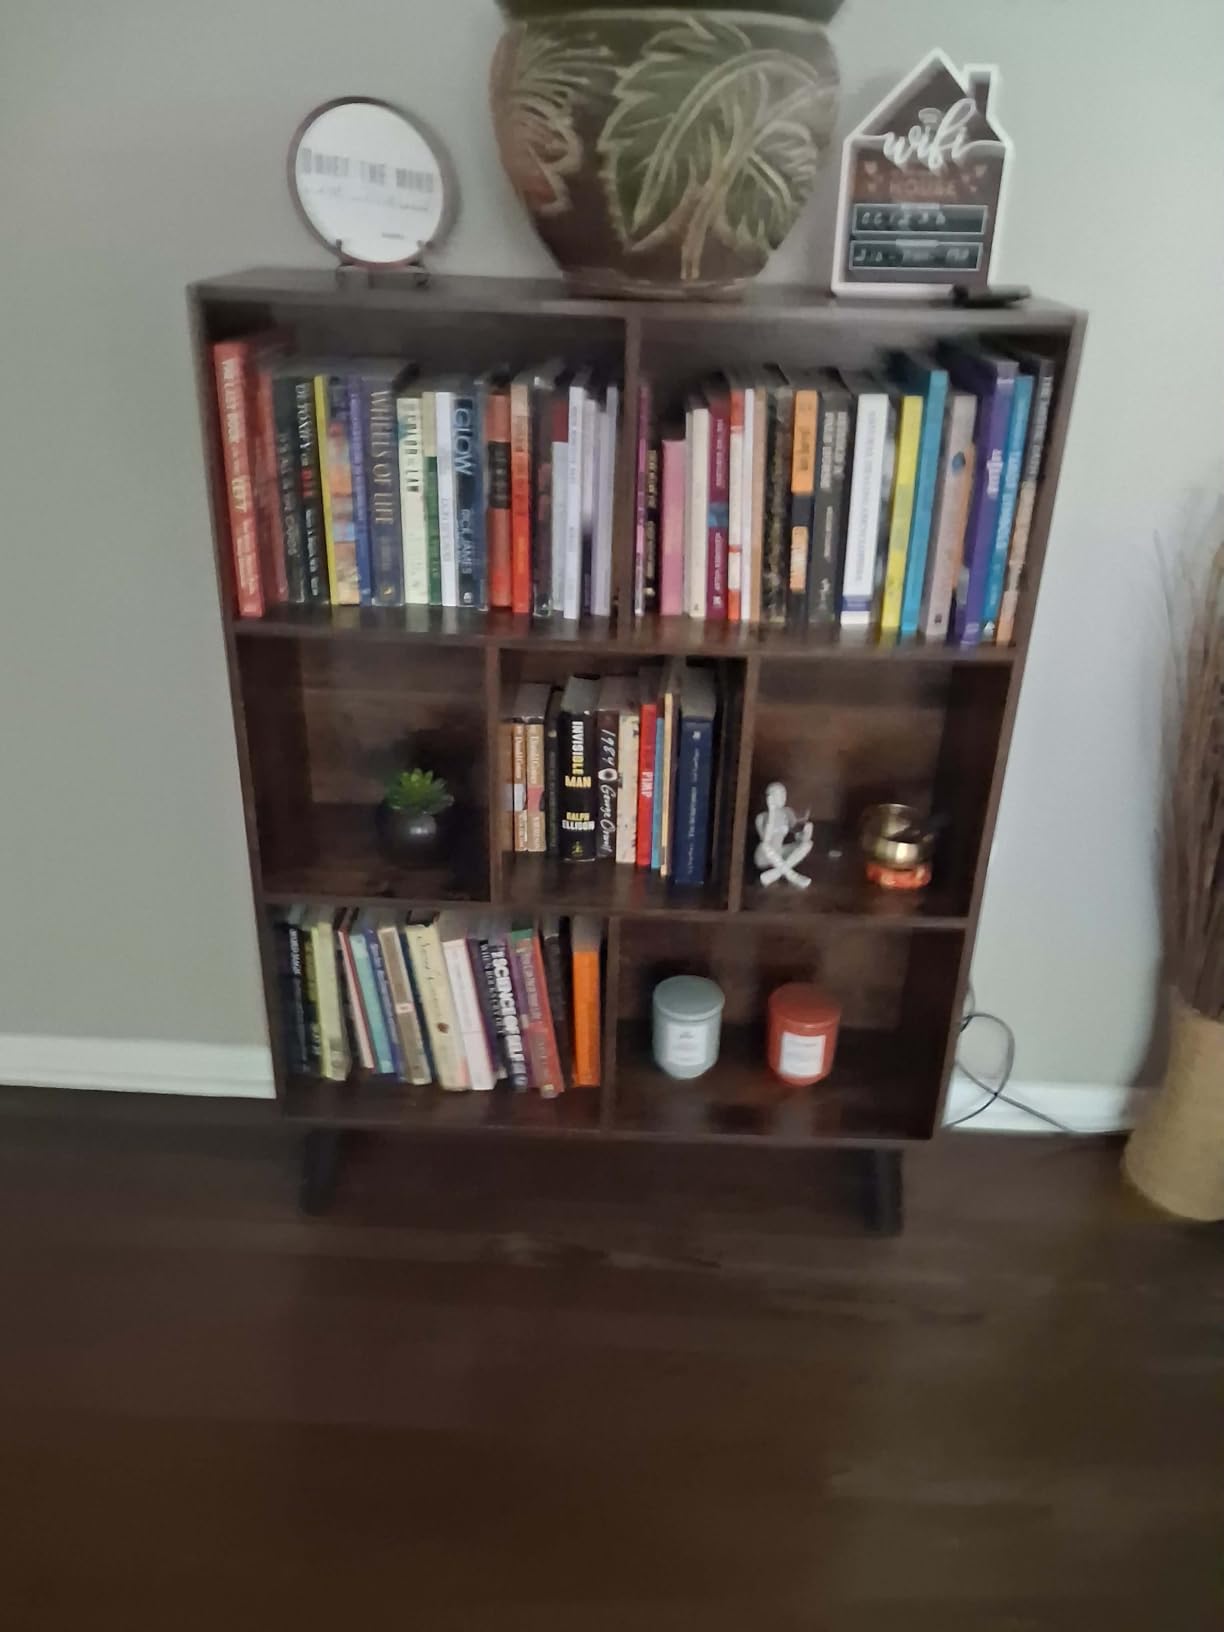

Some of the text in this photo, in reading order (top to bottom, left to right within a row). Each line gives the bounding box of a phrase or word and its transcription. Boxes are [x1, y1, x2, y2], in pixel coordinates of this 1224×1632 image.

[883, 97, 968, 175] wifi
[371, 390, 393, 457] WHEELS
[454, 407, 474, 475] GLOW
[373, 463, 392, 485] OF
[374, 492, 393, 526] LIFE
[571, 721, 584, 776] INVISIBLE
[600, 728, 617, 766] 1984
[564, 775, 592, 788] MAN
[641, 771, 653, 798] PIMP
[600, 784, 617, 853] George Orwell
